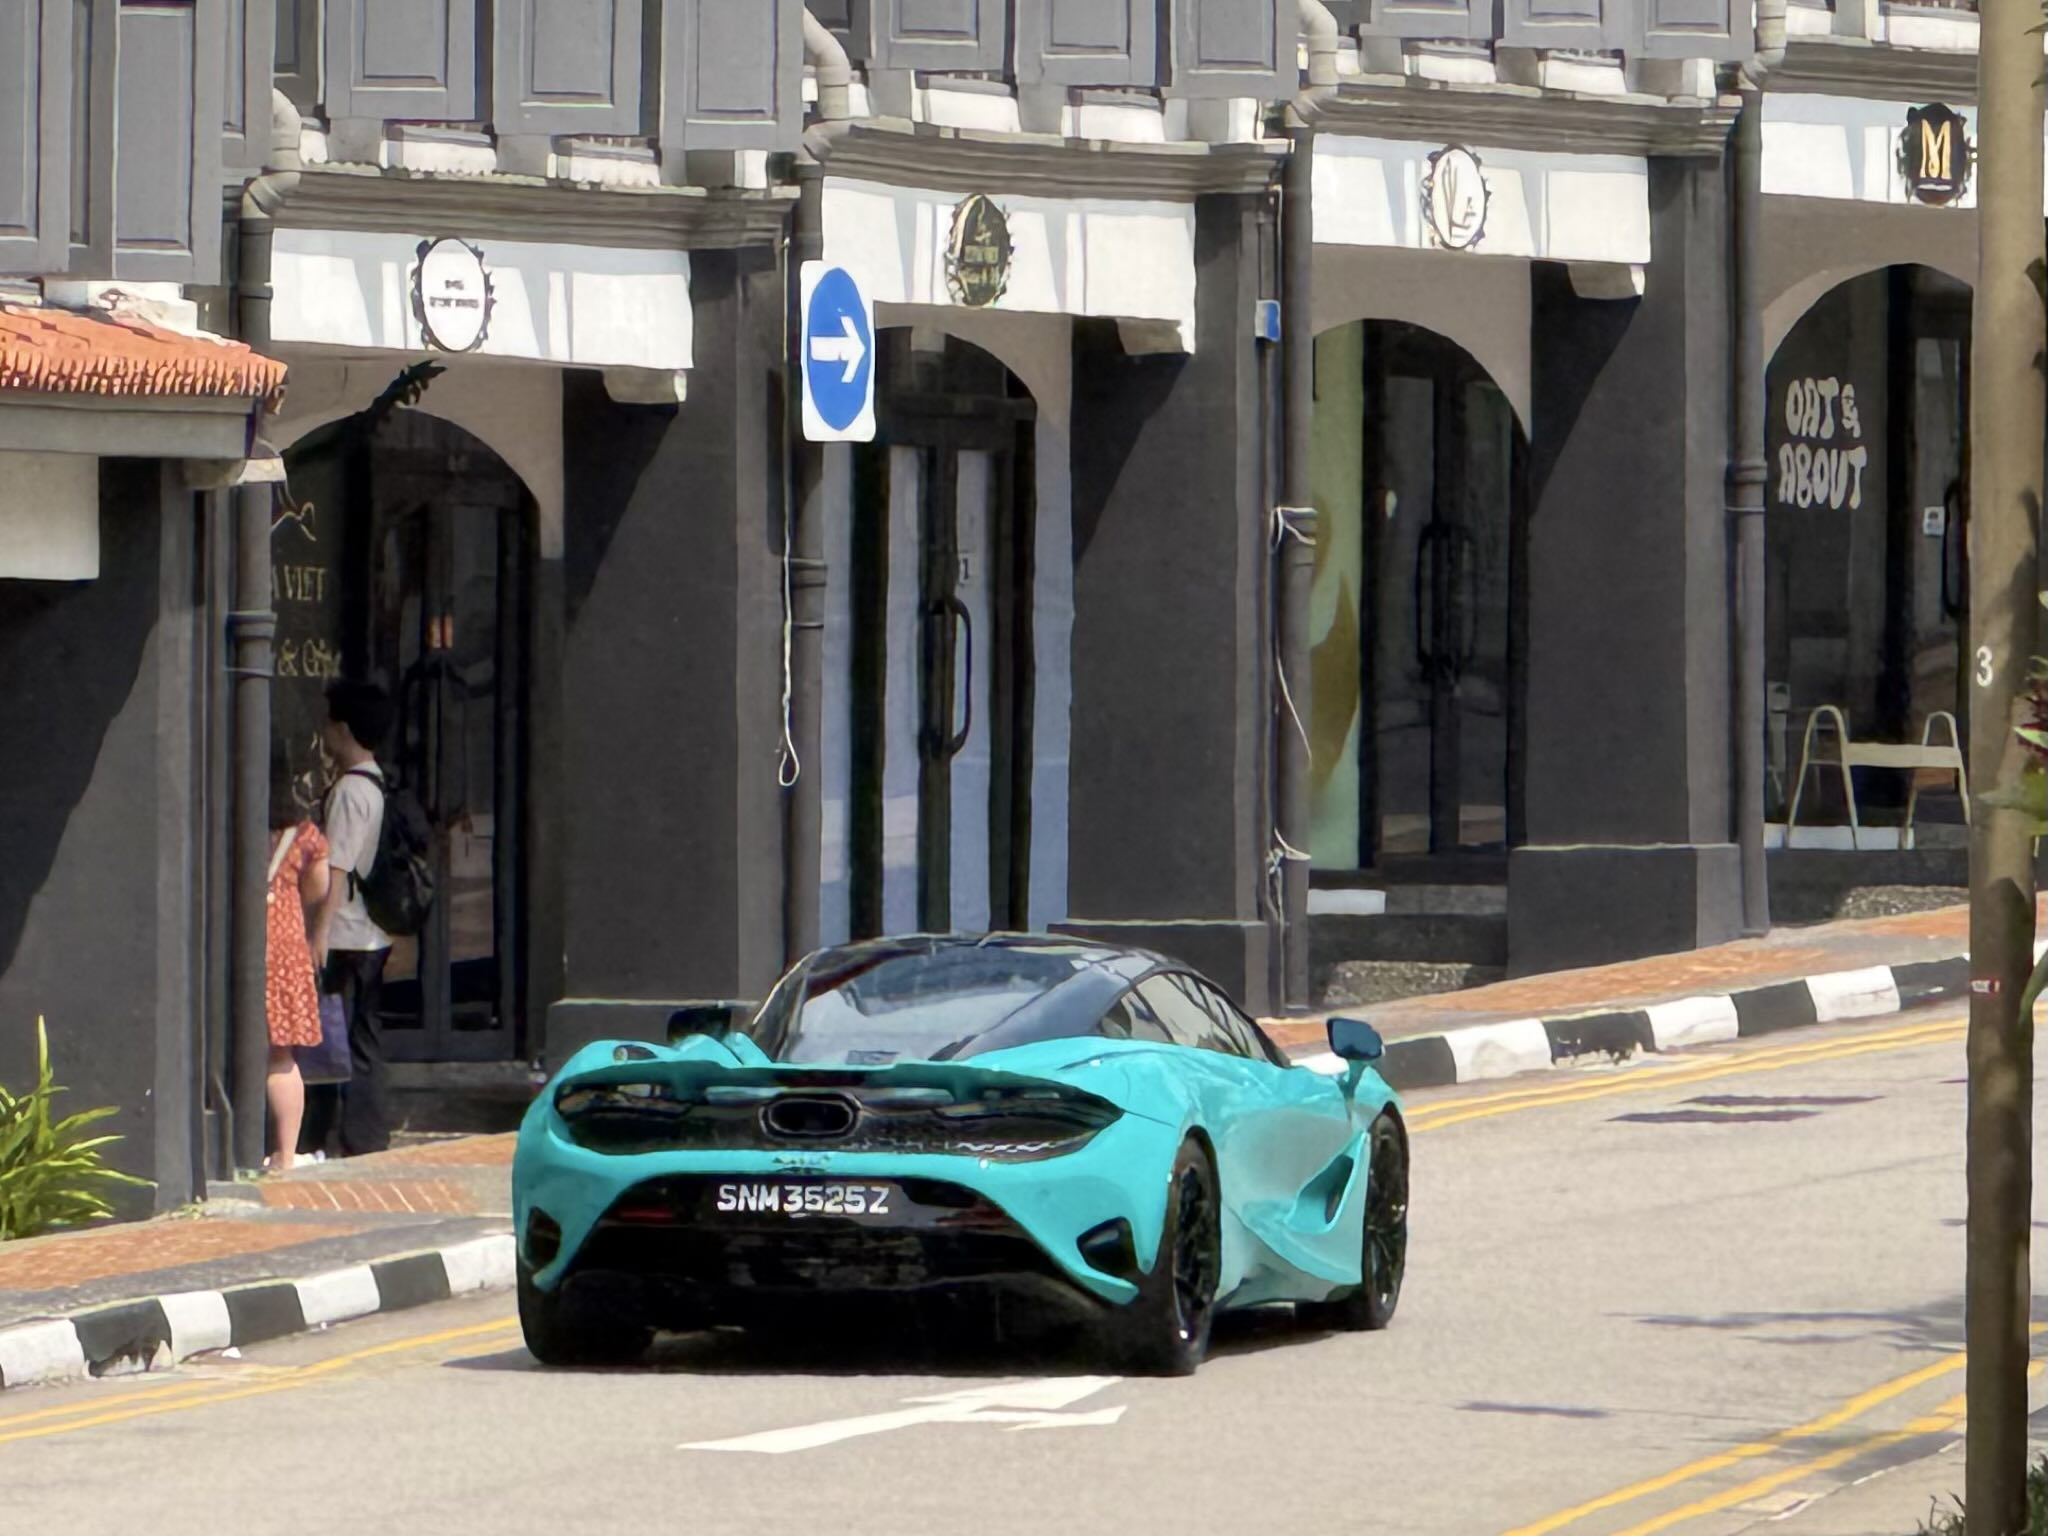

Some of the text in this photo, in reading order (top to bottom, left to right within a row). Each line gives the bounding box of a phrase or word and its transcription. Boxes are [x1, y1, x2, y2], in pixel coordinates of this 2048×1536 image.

[1920, 119, 1952, 180] M
[1785, 377, 1861, 439] OAT &
[1779, 443, 1868, 510] ABOUT
[1976, 645, 1993, 687] 3
